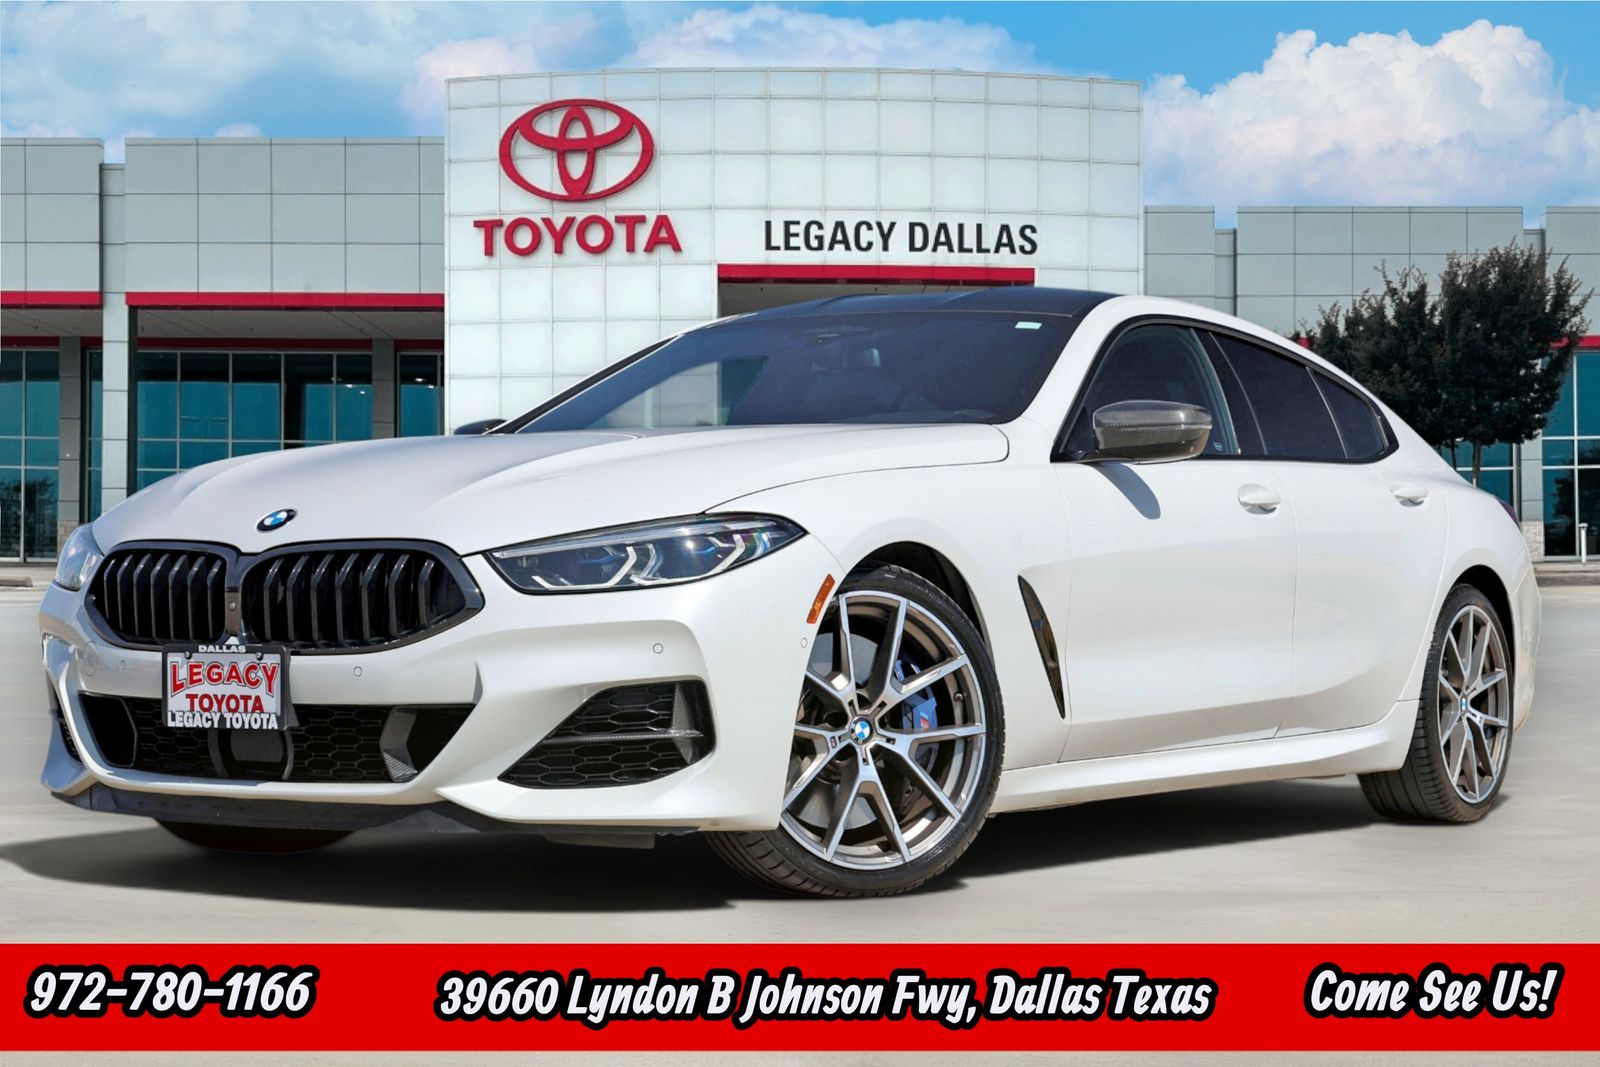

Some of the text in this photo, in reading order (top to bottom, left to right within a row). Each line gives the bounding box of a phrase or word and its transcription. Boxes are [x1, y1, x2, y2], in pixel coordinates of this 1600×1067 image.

[473, 214, 683, 256] TOYOTA
[765, 220, 1039, 255] LEGACY DALLAS
[198, 645, 247, 653] DALLAS
[170, 661, 280, 697] LEGACY
[185, 693, 265, 713] TOYOTA
[167, 711, 279, 730] LEGACY TOYOTA
